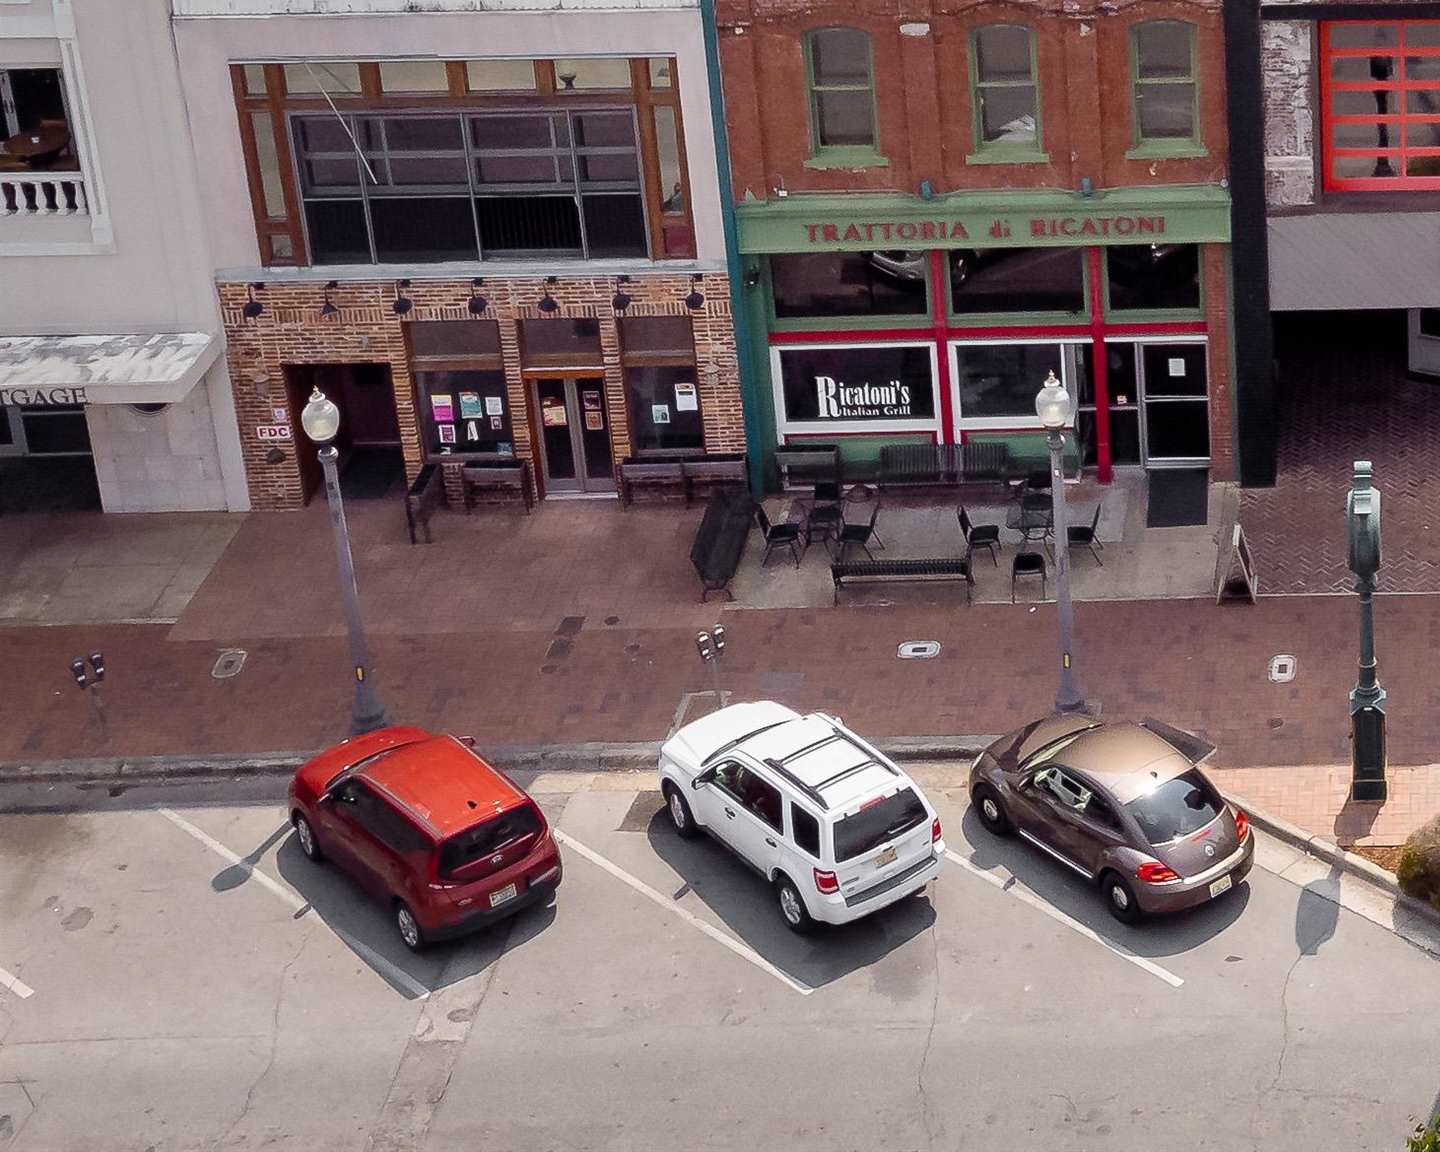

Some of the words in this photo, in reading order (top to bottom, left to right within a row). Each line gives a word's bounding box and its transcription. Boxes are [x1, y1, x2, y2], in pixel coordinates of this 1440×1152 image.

[805, 221, 969, 242] TRATTORIA
[989, 218, 1011, 240] di
[1029, 214, 1165, 239] RICATONI
[814, 375, 911, 418] Ricatoni's
[842, 407, 880, 417] Italian
[883, 405, 911, 416] Grill
[259, 427, 288, 437] FDC
